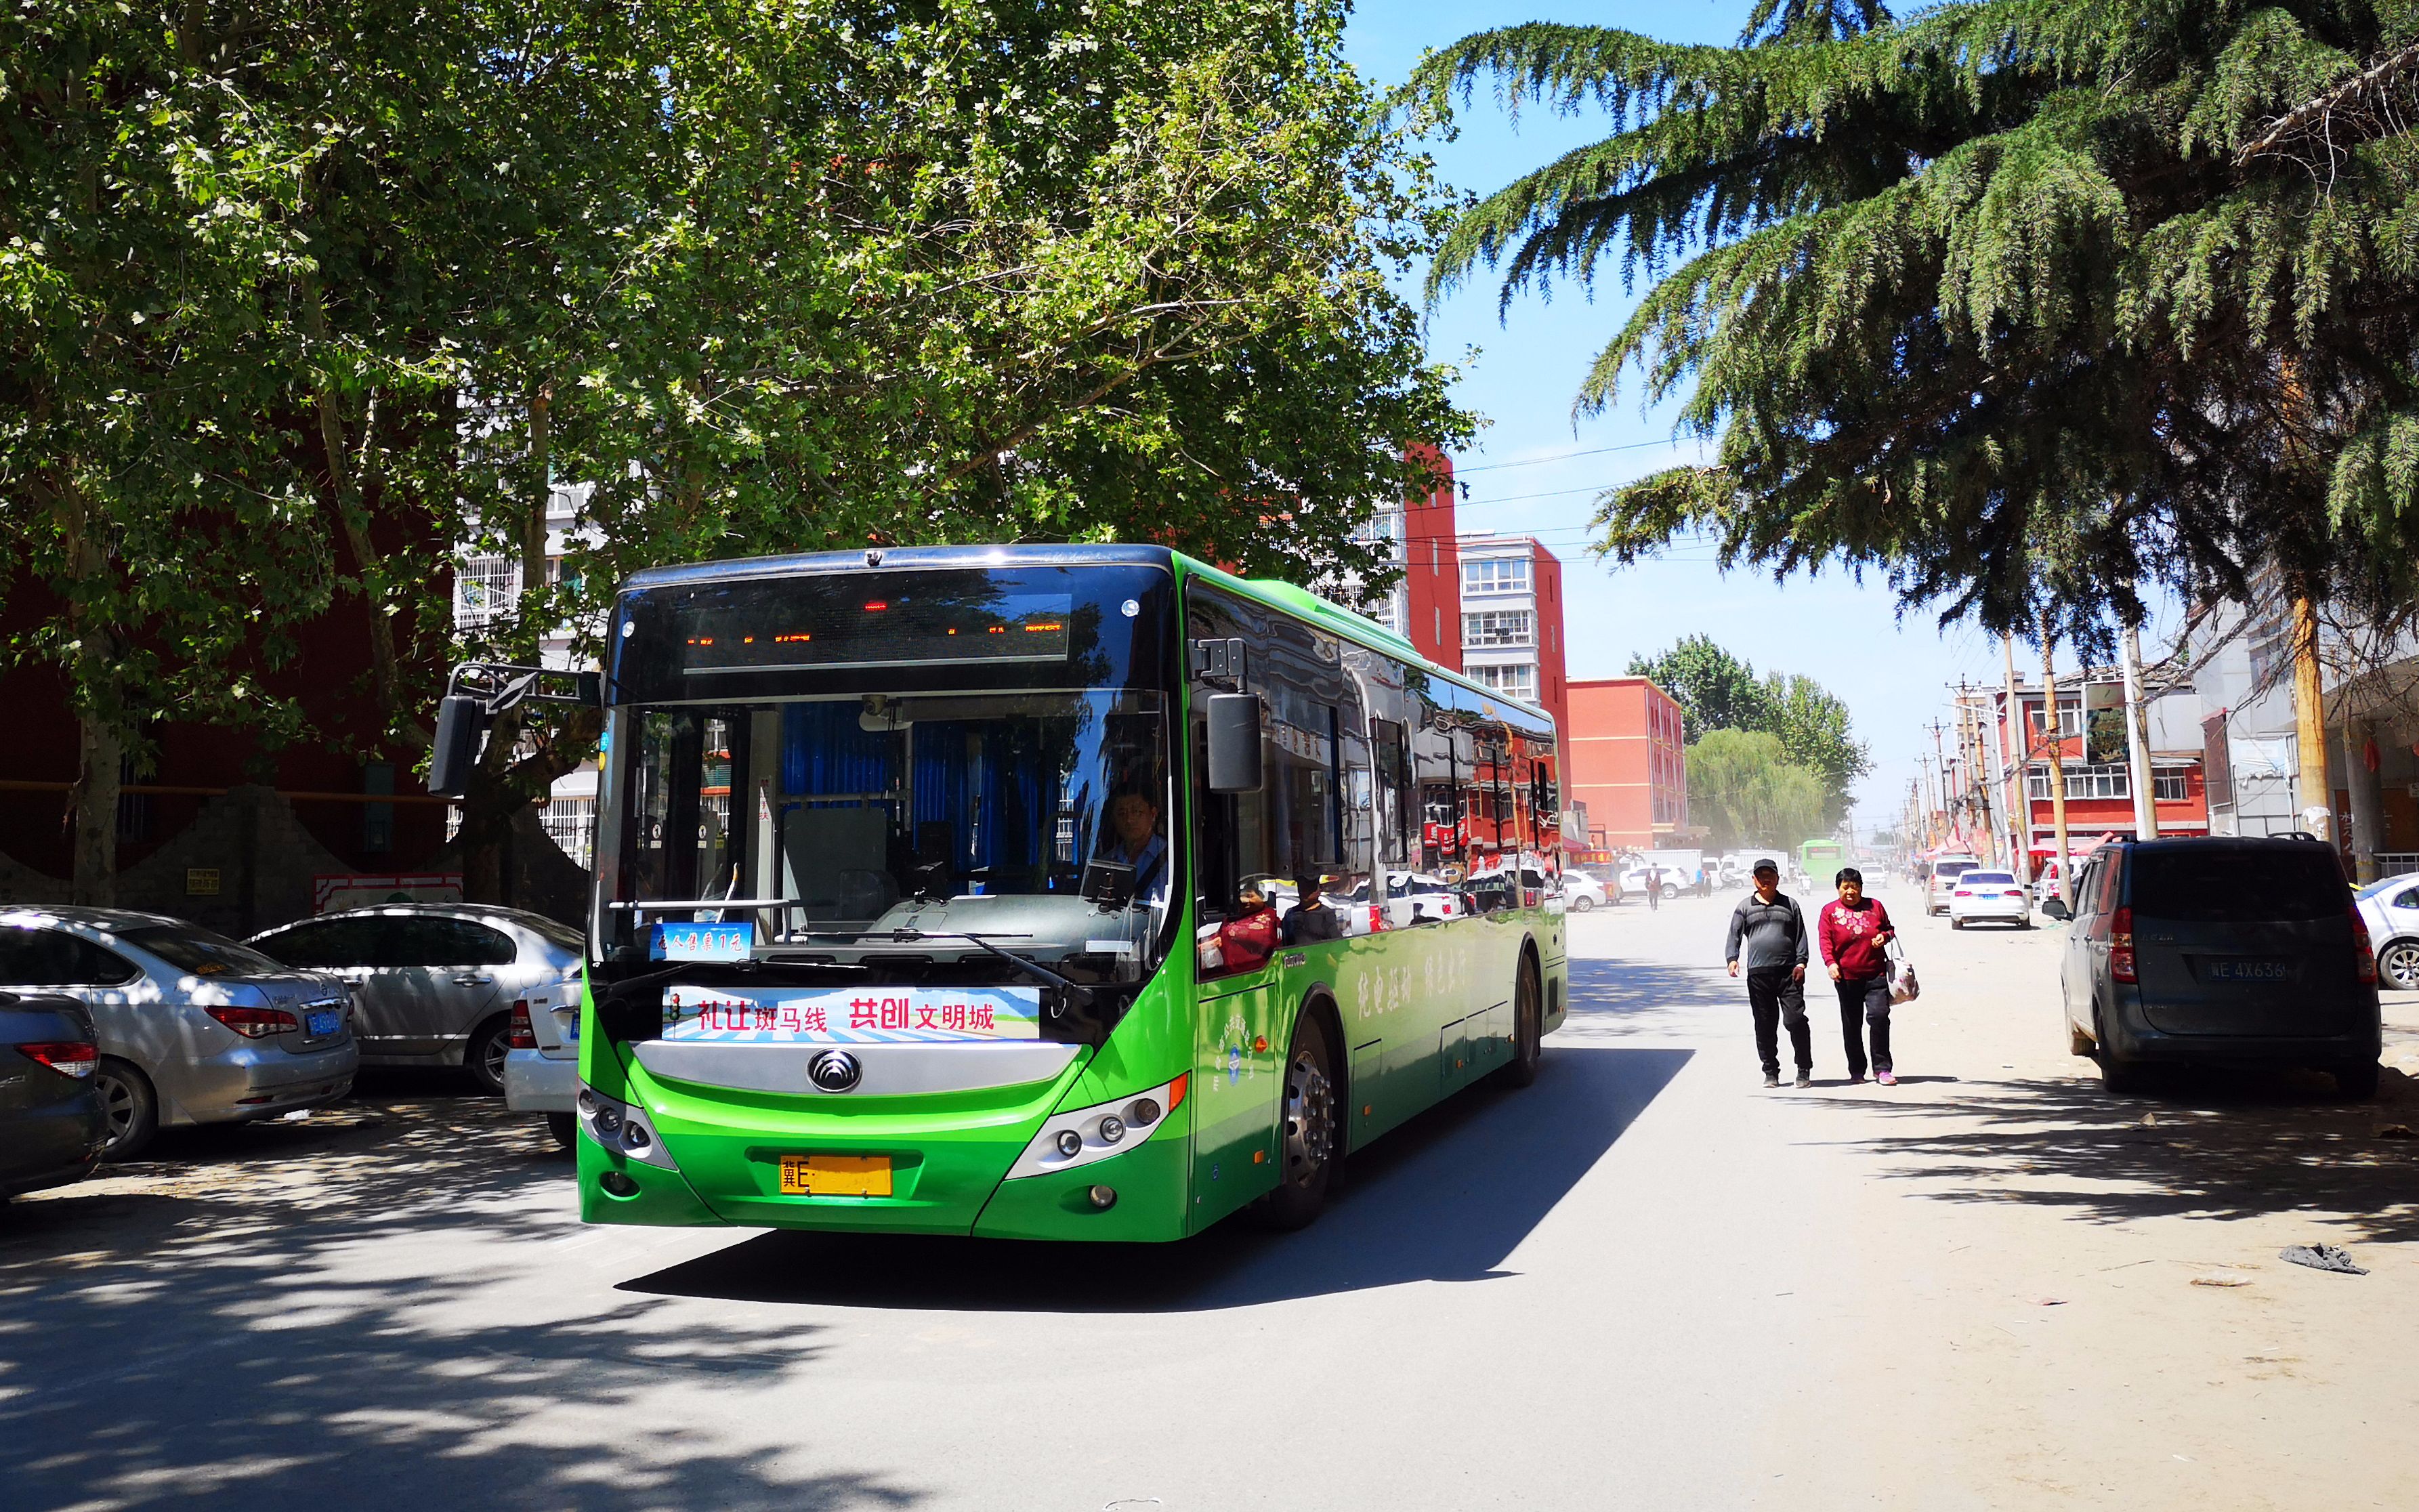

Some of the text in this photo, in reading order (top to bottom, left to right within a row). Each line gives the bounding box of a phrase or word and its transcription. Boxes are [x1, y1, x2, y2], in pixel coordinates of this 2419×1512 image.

[697, 998, 995, 1033] 礼让斑马线 共创文明城
[782, 1160, 810, 1188] 冀E
